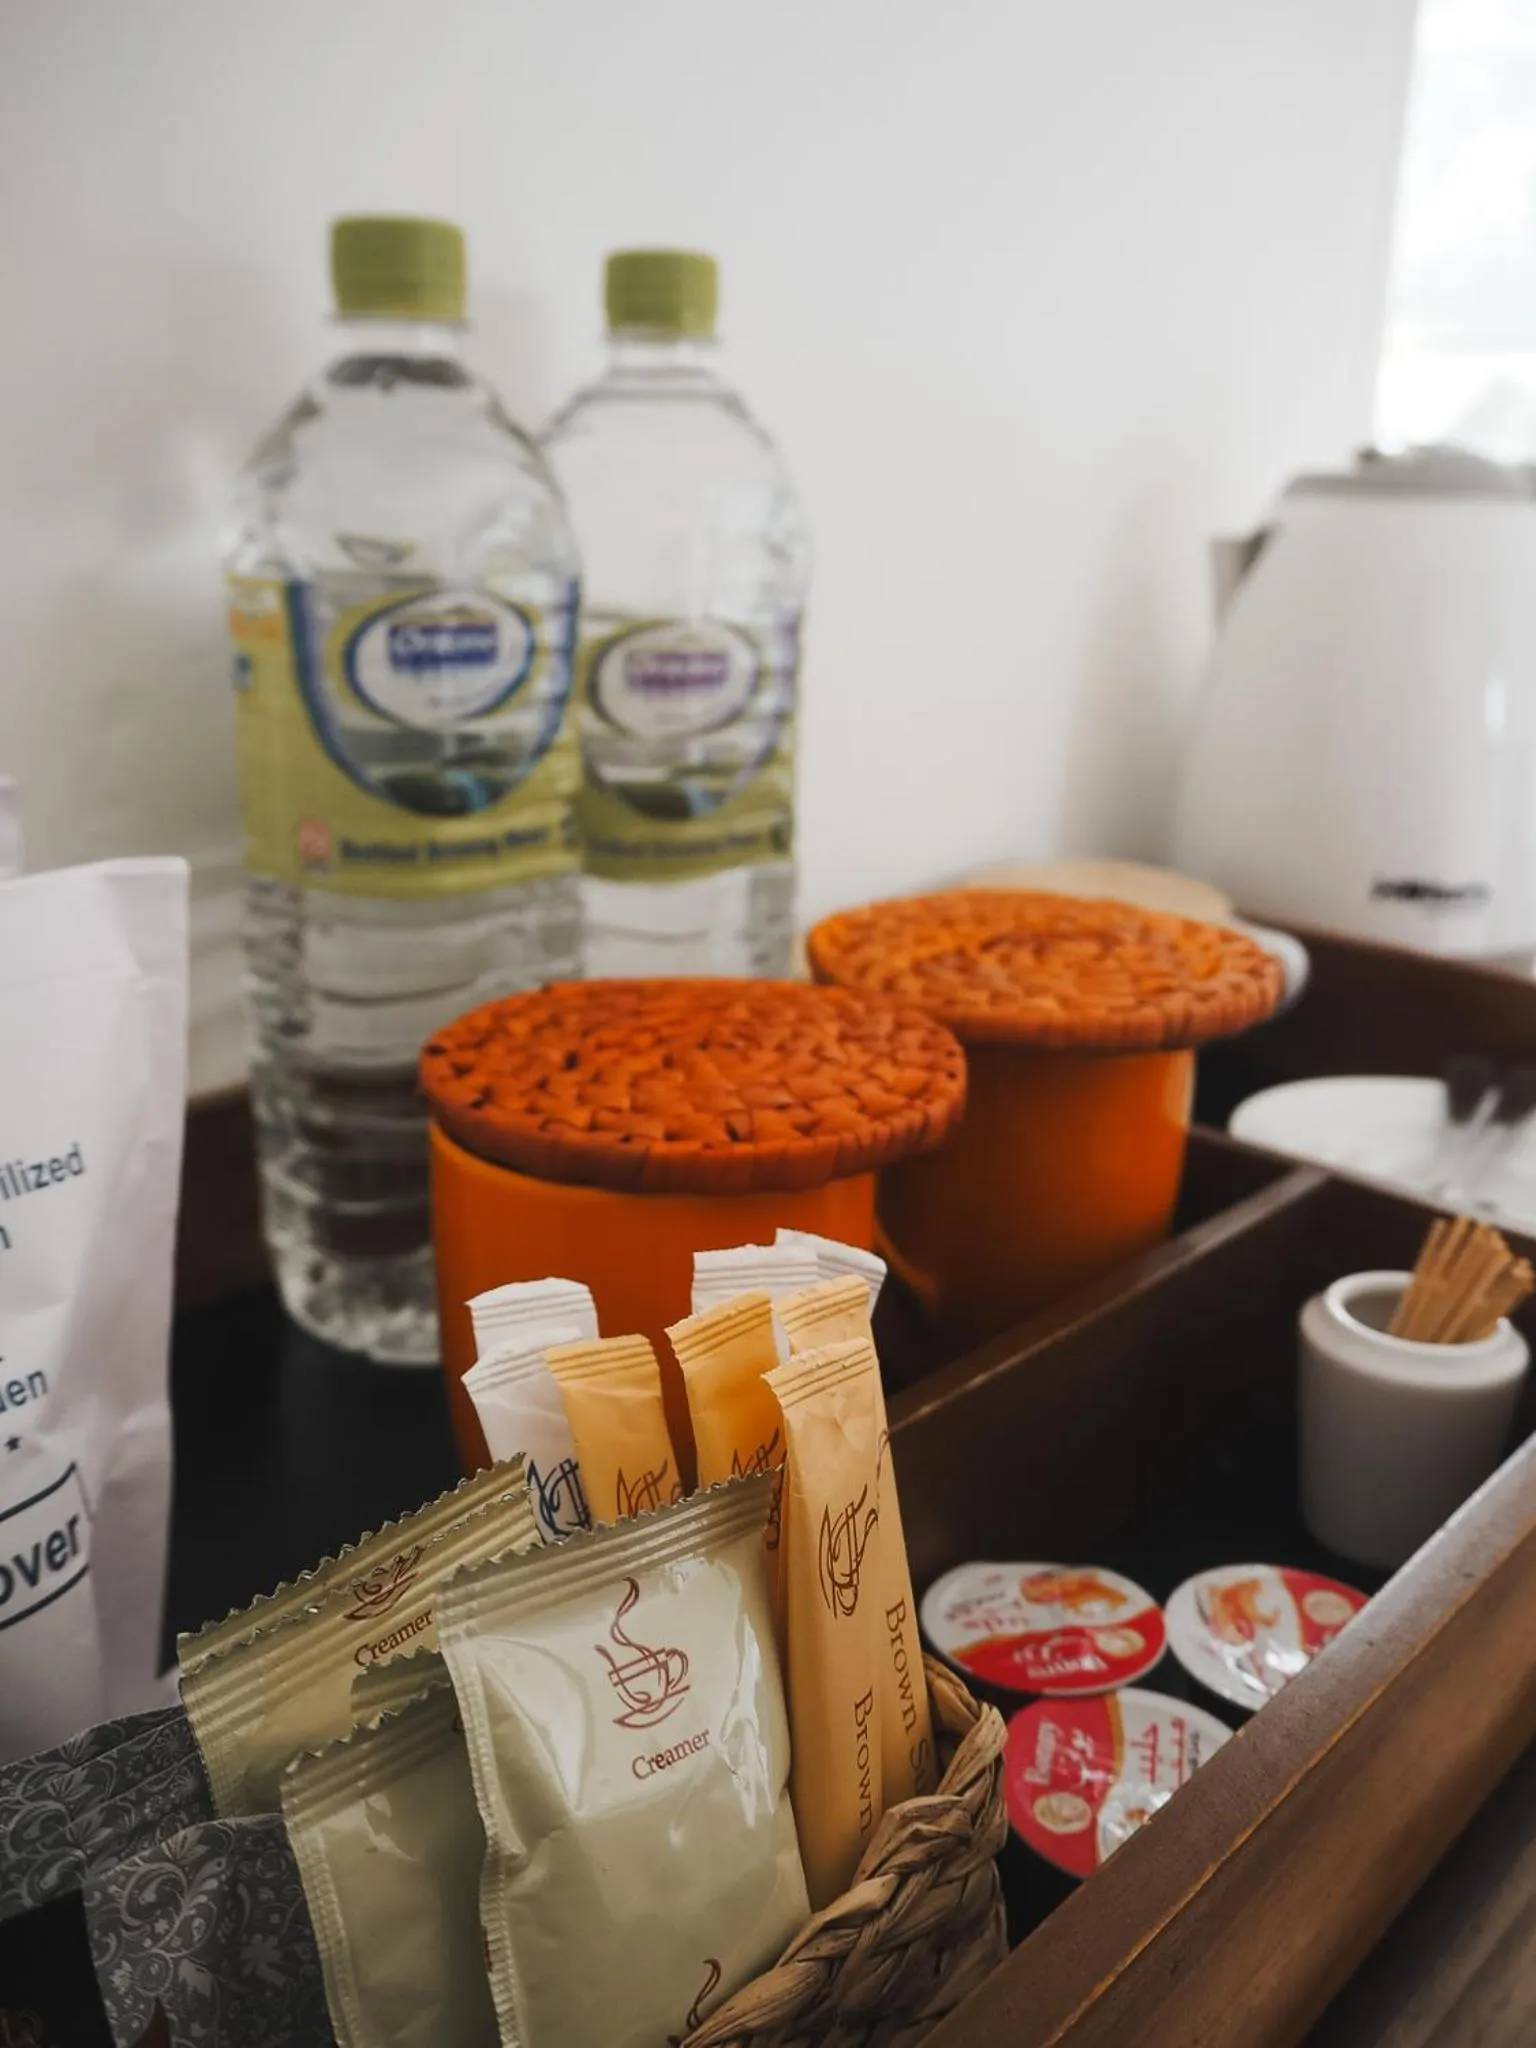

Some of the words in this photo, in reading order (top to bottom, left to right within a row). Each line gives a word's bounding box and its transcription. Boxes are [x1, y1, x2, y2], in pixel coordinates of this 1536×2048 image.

[0, 1369, 48, 1413] en
[354, 1609, 433, 1668] Creamer
[885, 1598, 918, 1737] Brown
[631, 1729, 709, 1780] Creamer
[854, 1684, 874, 1835] Brown
